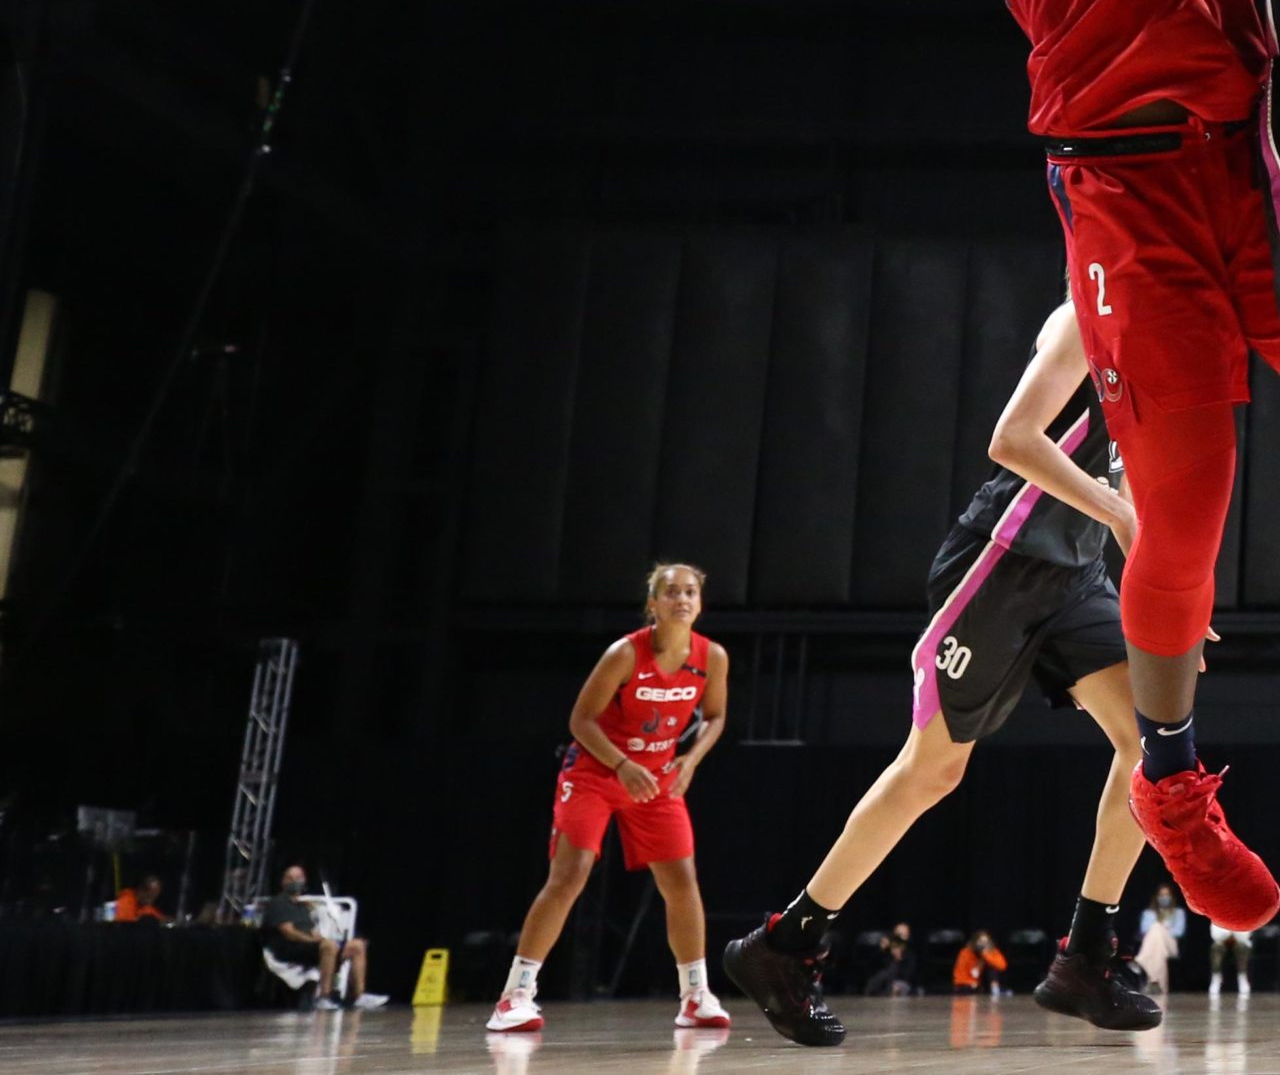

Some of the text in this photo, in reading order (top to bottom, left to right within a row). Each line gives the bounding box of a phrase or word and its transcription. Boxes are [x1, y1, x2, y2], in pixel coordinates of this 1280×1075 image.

[1088, 262, 1113, 317] 2
[935, 635, 972, 680] 30
[635, 686, 697, 702] GEICO
